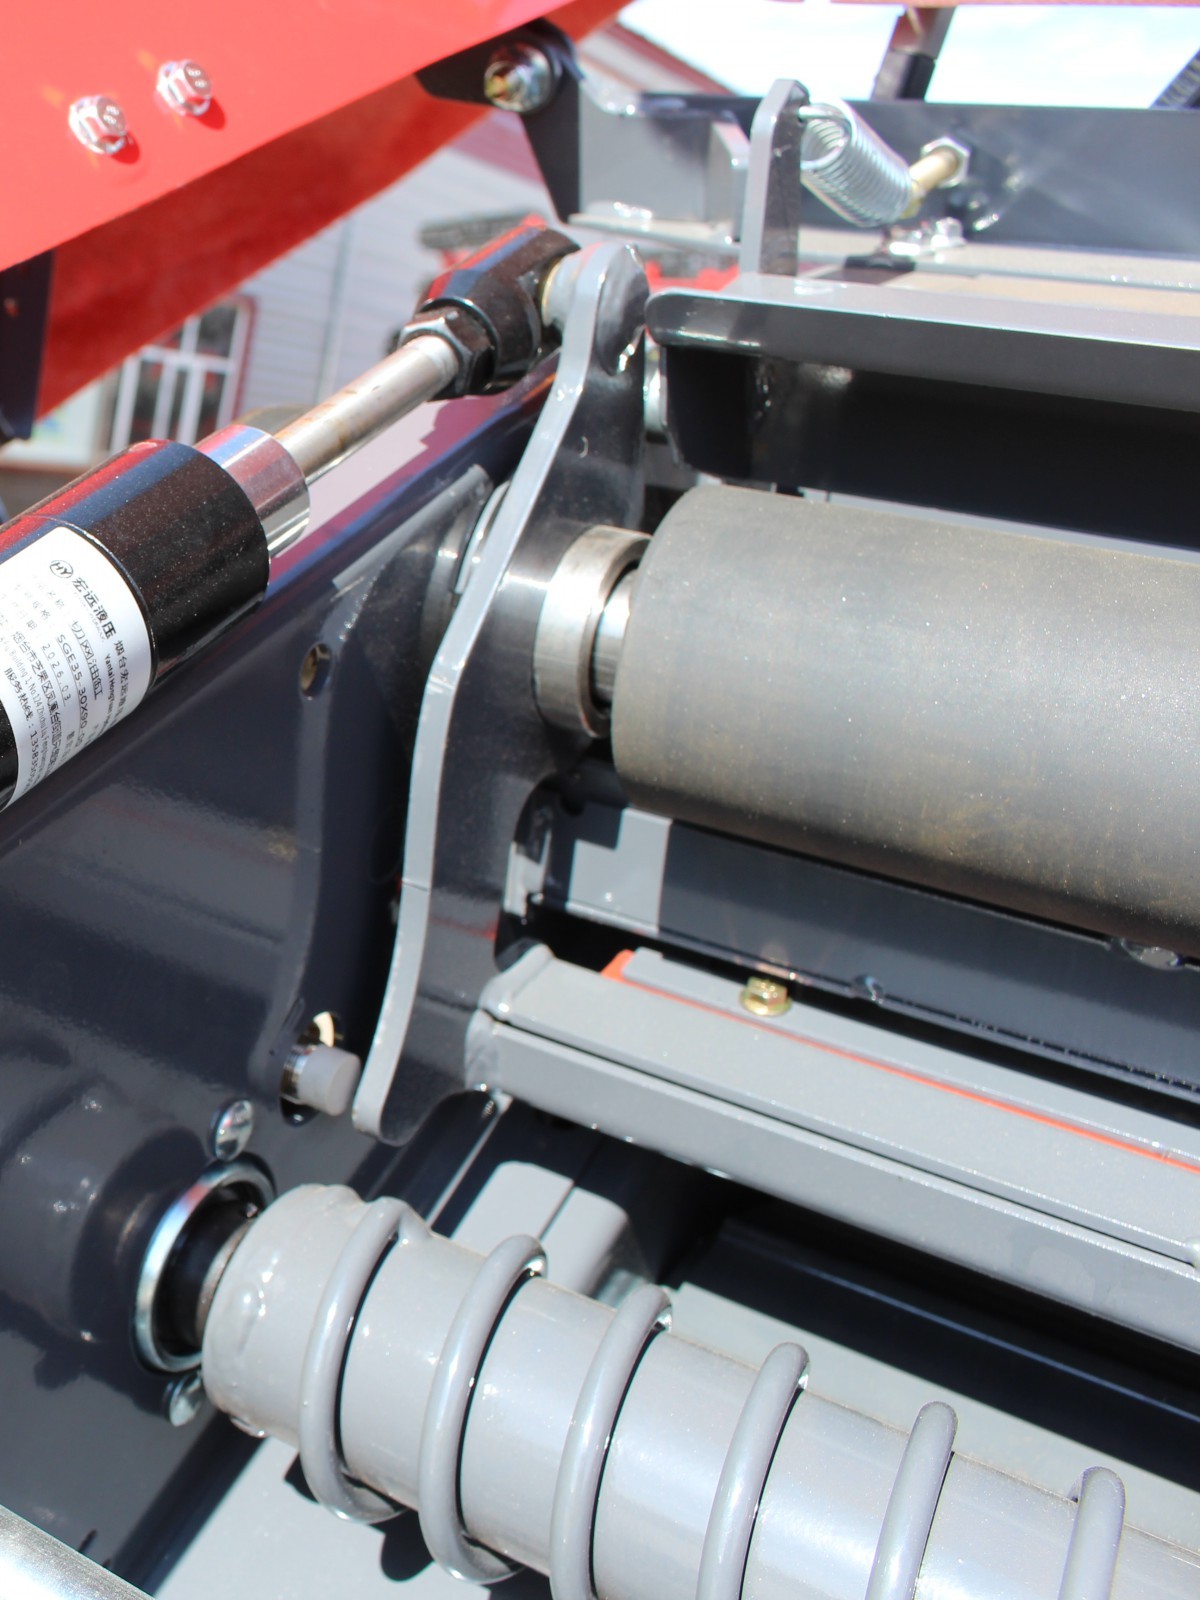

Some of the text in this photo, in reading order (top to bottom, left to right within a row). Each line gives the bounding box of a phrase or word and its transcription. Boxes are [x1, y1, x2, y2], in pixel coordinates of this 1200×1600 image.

[72, 577, 117, 639] 宏远液压
[71, 621, 103, 699] 切网油缸
[105, 653, 115, 679] Yantai
